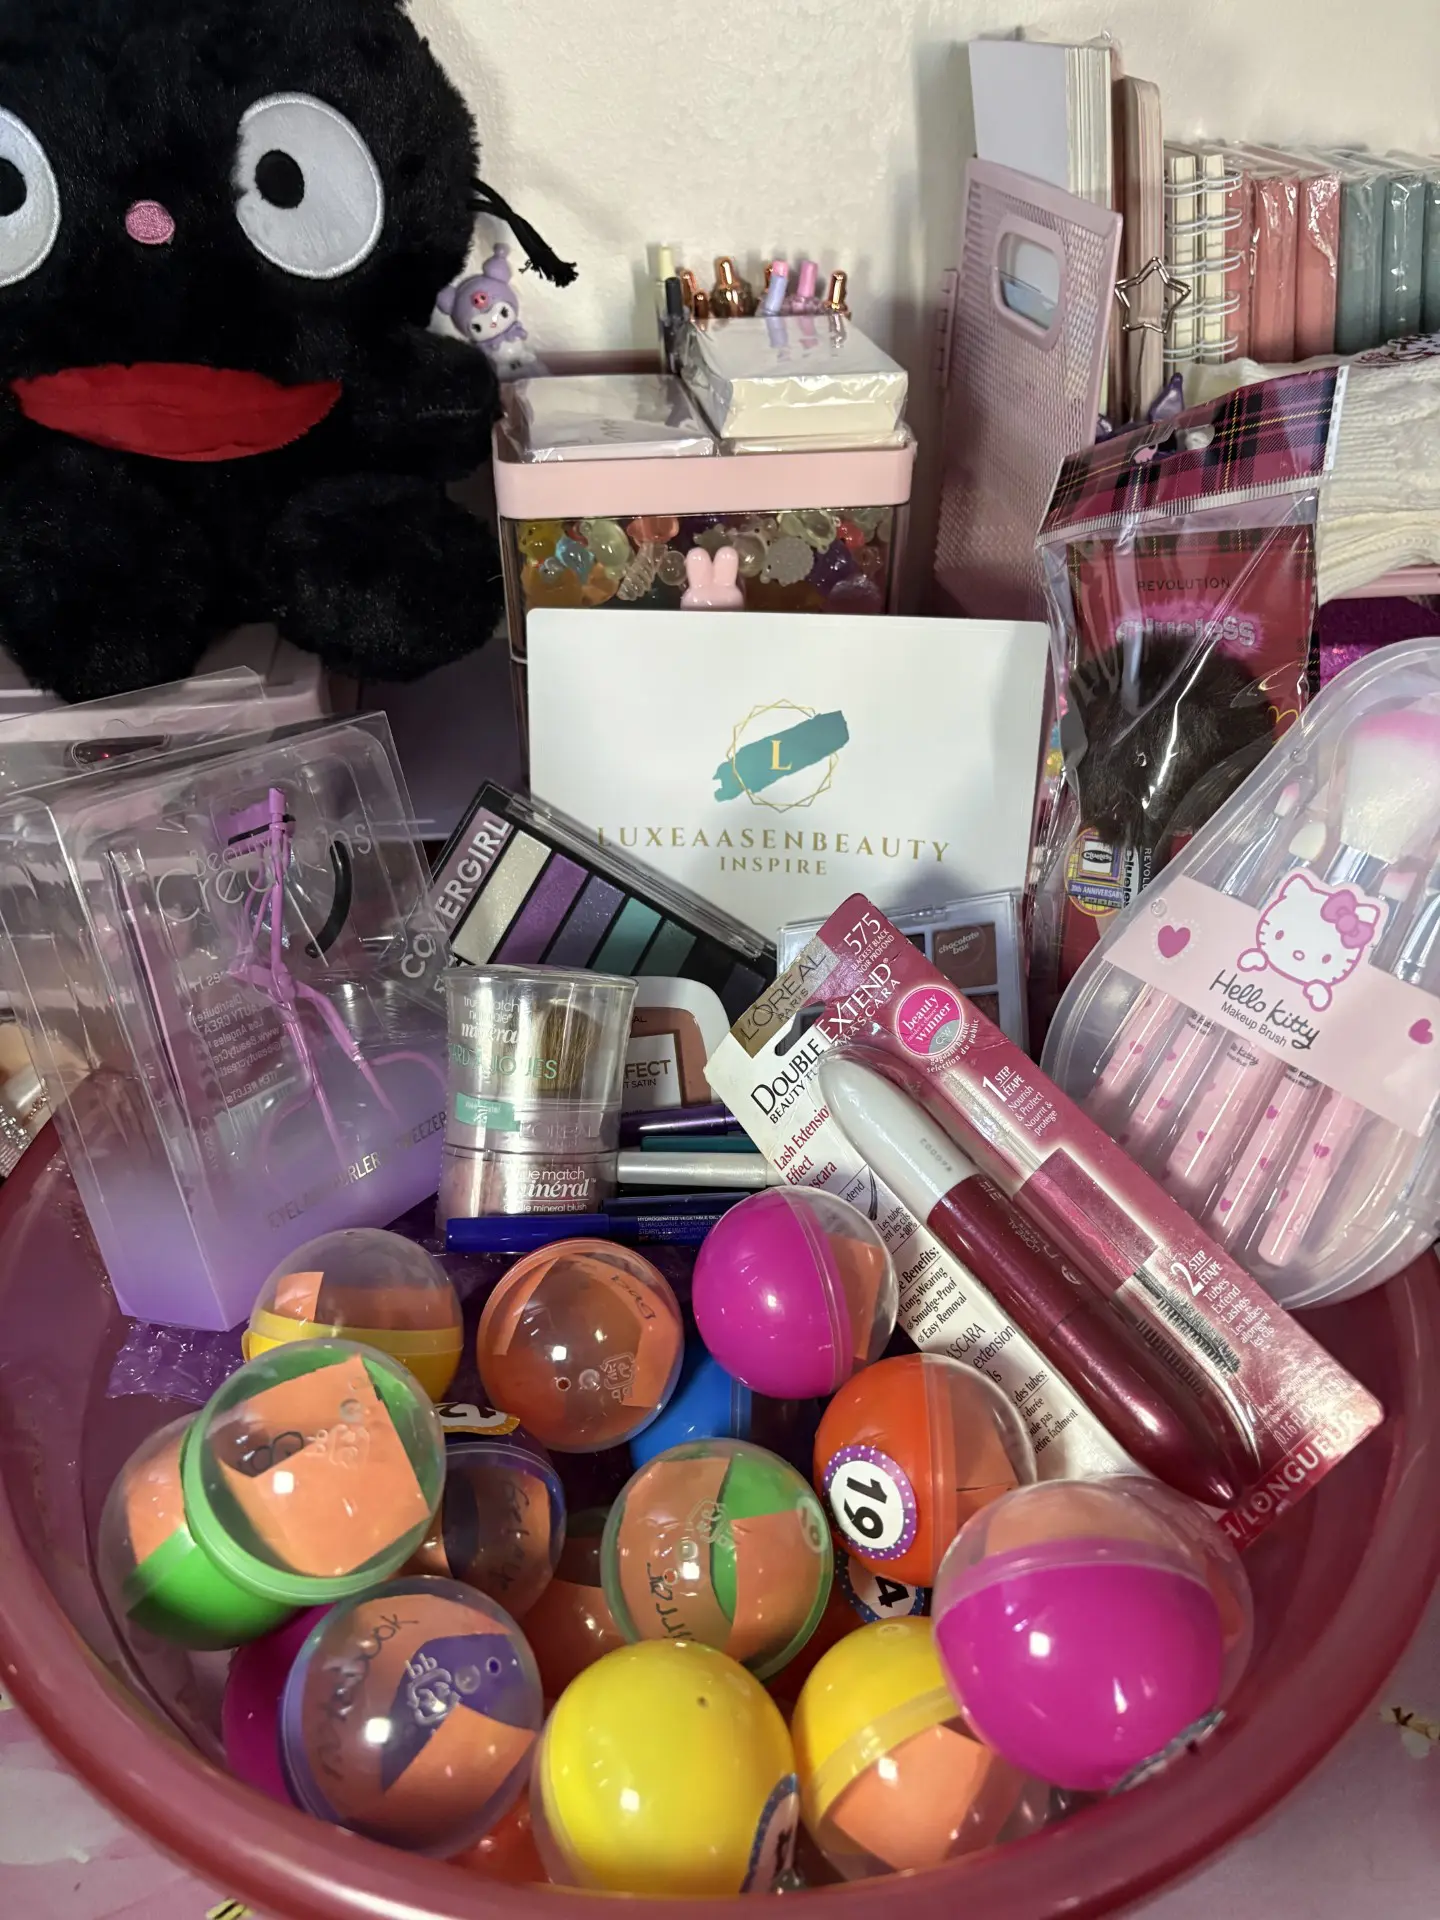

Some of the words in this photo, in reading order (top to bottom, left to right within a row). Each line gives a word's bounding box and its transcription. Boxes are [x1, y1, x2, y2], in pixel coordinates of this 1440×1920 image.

[1137, 577, 1230, 592] REVOLUTION
[769, 740, 793, 771] L
[597, 826, 950, 862] LUXEAASENBEAUTY
[719, 856, 828, 876] INSPIRE
[401, 821, 511, 978] COVERGIRL
[844, 913, 881, 956] 575
[851, 942, 876, 971] BLACKEST
[872, 929, 890, 950] BLACK
[869, 934, 895, 962] PROFOND
[938, 931, 980, 954] chocolate
[952, 942, 969, 955] box
[778, 988, 809, 1022] PARIS
[1209, 968, 1267, 1013] Hello
[835, 979, 901, 1046] MASCARA
[902, 994, 939, 1031] beauty
[916, 1003, 952, 1042] winner
[1220, 1001, 1258, 1030] Makeup
[1258, 1023, 1287, 1048] Brush
[960, 1045, 970, 1056] du
[968, 1019, 980, 1044] public
[624, 1059, 672, 1081] FECT
[631, 1078, 657, 1089] SATIN
[751, 1039, 825, 1116] DOUBLE
[994, 1065, 1011, 1084] STEP
[769, 1080, 806, 1125] BEAUTY
[982, 1076, 1008, 1103] 1
[1008, 1085, 1035, 1112] Nourish
[1014, 1112, 1025, 1122] &
[1020, 1091, 1045, 1116] Protect
[1024, 1107, 1048, 1130] Nourrit
[1045, 1101, 1054, 1109] &
[542, 1166, 586, 1181] match
[774, 1144, 797, 1172] Lash
[785, 1155, 815, 1186] Effect
[845, 1179, 866, 1203] xtend
[533, 1203, 566, 1213] mineral
[566, 1203, 588, 1212] blush
[877, 1217, 890, 1232] Les
[902, 1246, 940, 1284] Benefits:
[1170, 1262, 1204, 1297] 2
[1188, 1250, 1208, 1272] STEP
[900, 1267, 948, 1313] Long-Wearing
[911, 1276, 958, 1327] Smudge-Proof
[1203, 1278, 1231, 1302] Tubes
[1211, 1284, 1242, 1315] Extend
[922, 1320, 942, 1340] Easy
[936, 1291, 967, 1324] Removal
[1221, 1296, 1251, 1324] Lashes
[1230, 1322, 1245, 1336] Les
[1242, 1305, 1263, 1326] tubes
[1240, 1312, 1272, 1344] allongent
[972, 1325, 1016, 1370] extension
[1015, 1386, 1029, 1402] des
[1041, 1411, 1054, 1428] pas
[843, 1476, 888, 1540] 19
